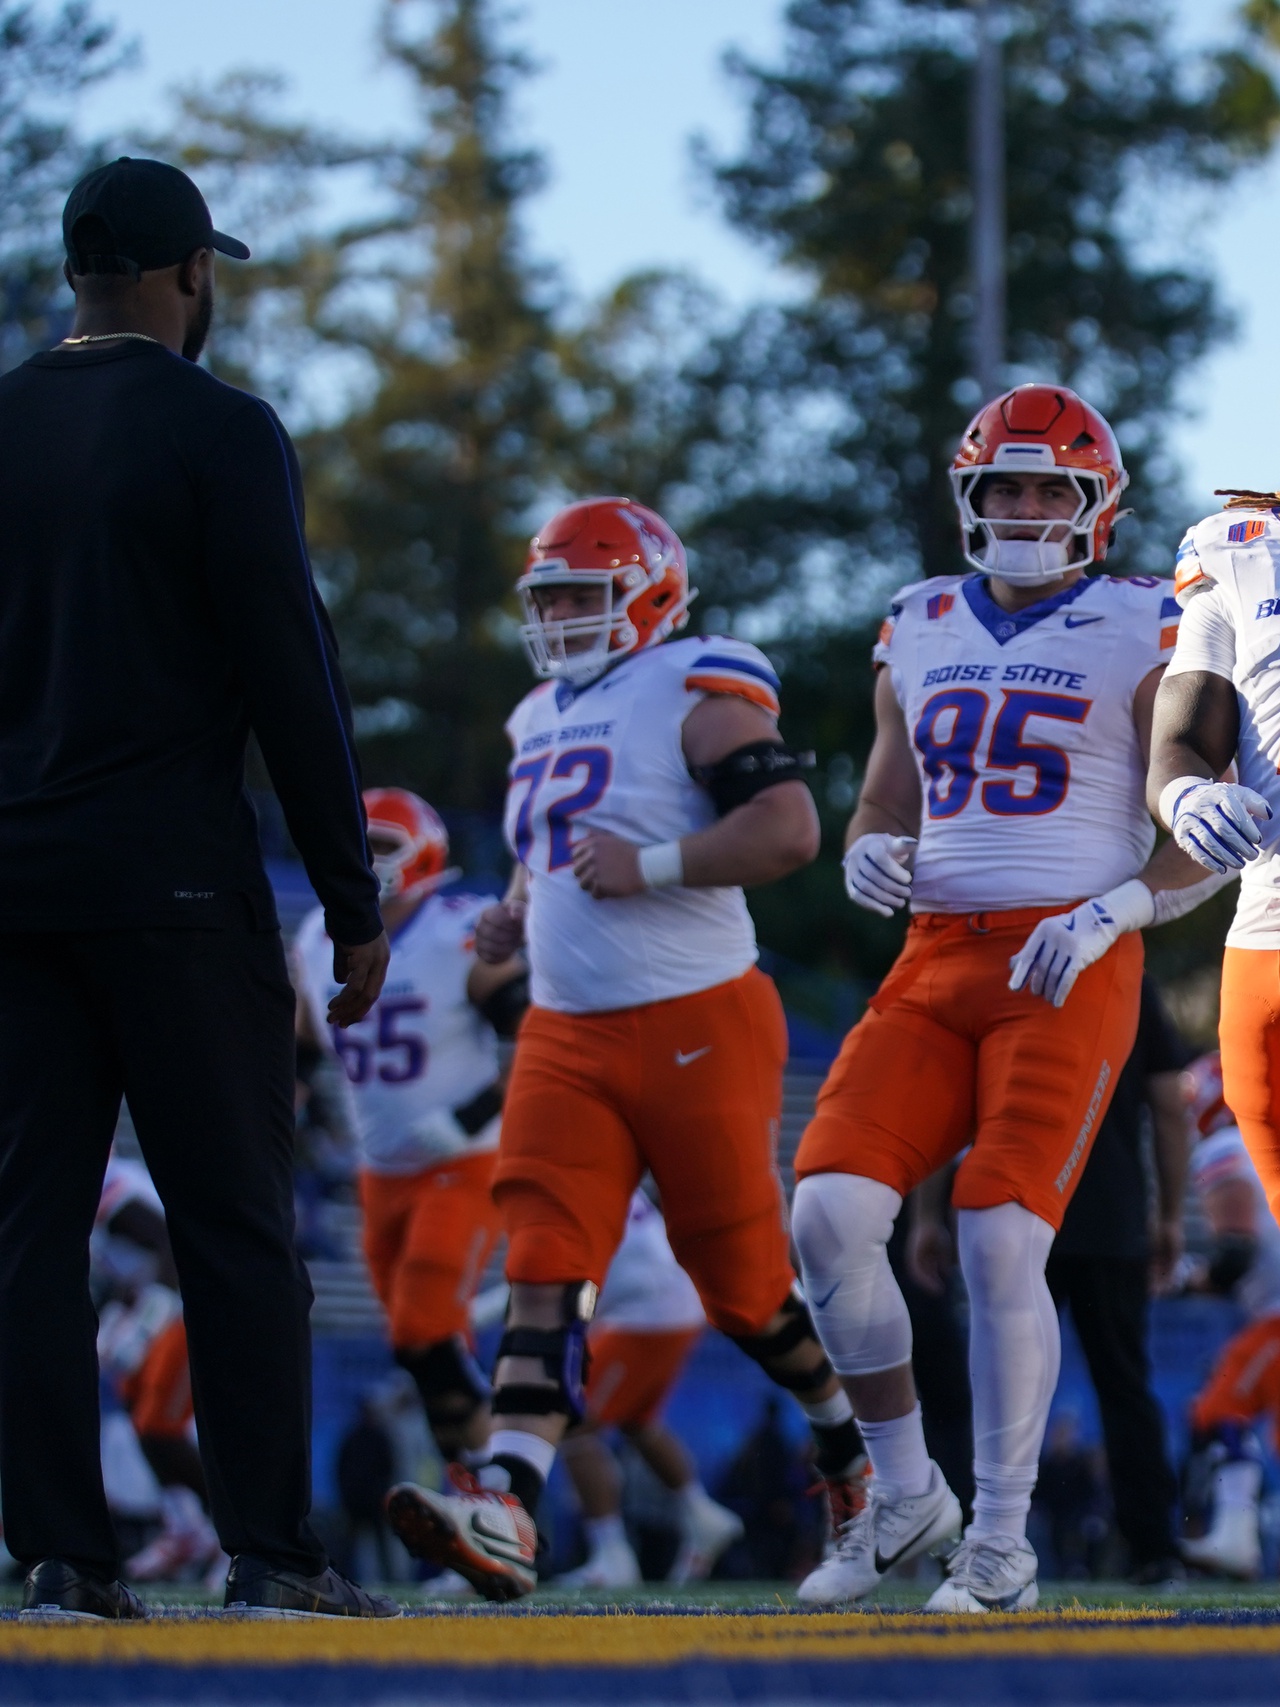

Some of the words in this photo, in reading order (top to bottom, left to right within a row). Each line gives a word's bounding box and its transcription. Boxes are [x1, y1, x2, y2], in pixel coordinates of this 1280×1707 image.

[923, 664, 998, 687] BOISE
[1002, 664, 1087, 690] STATE
[914, 688, 1093, 819] 85
[510, 744, 613, 880] 72
[174, 890, 215, 899] DRI-FIT
[332, 995, 431, 1087] 65
[1055, 1059, 1111, 1193] BRONCOS
